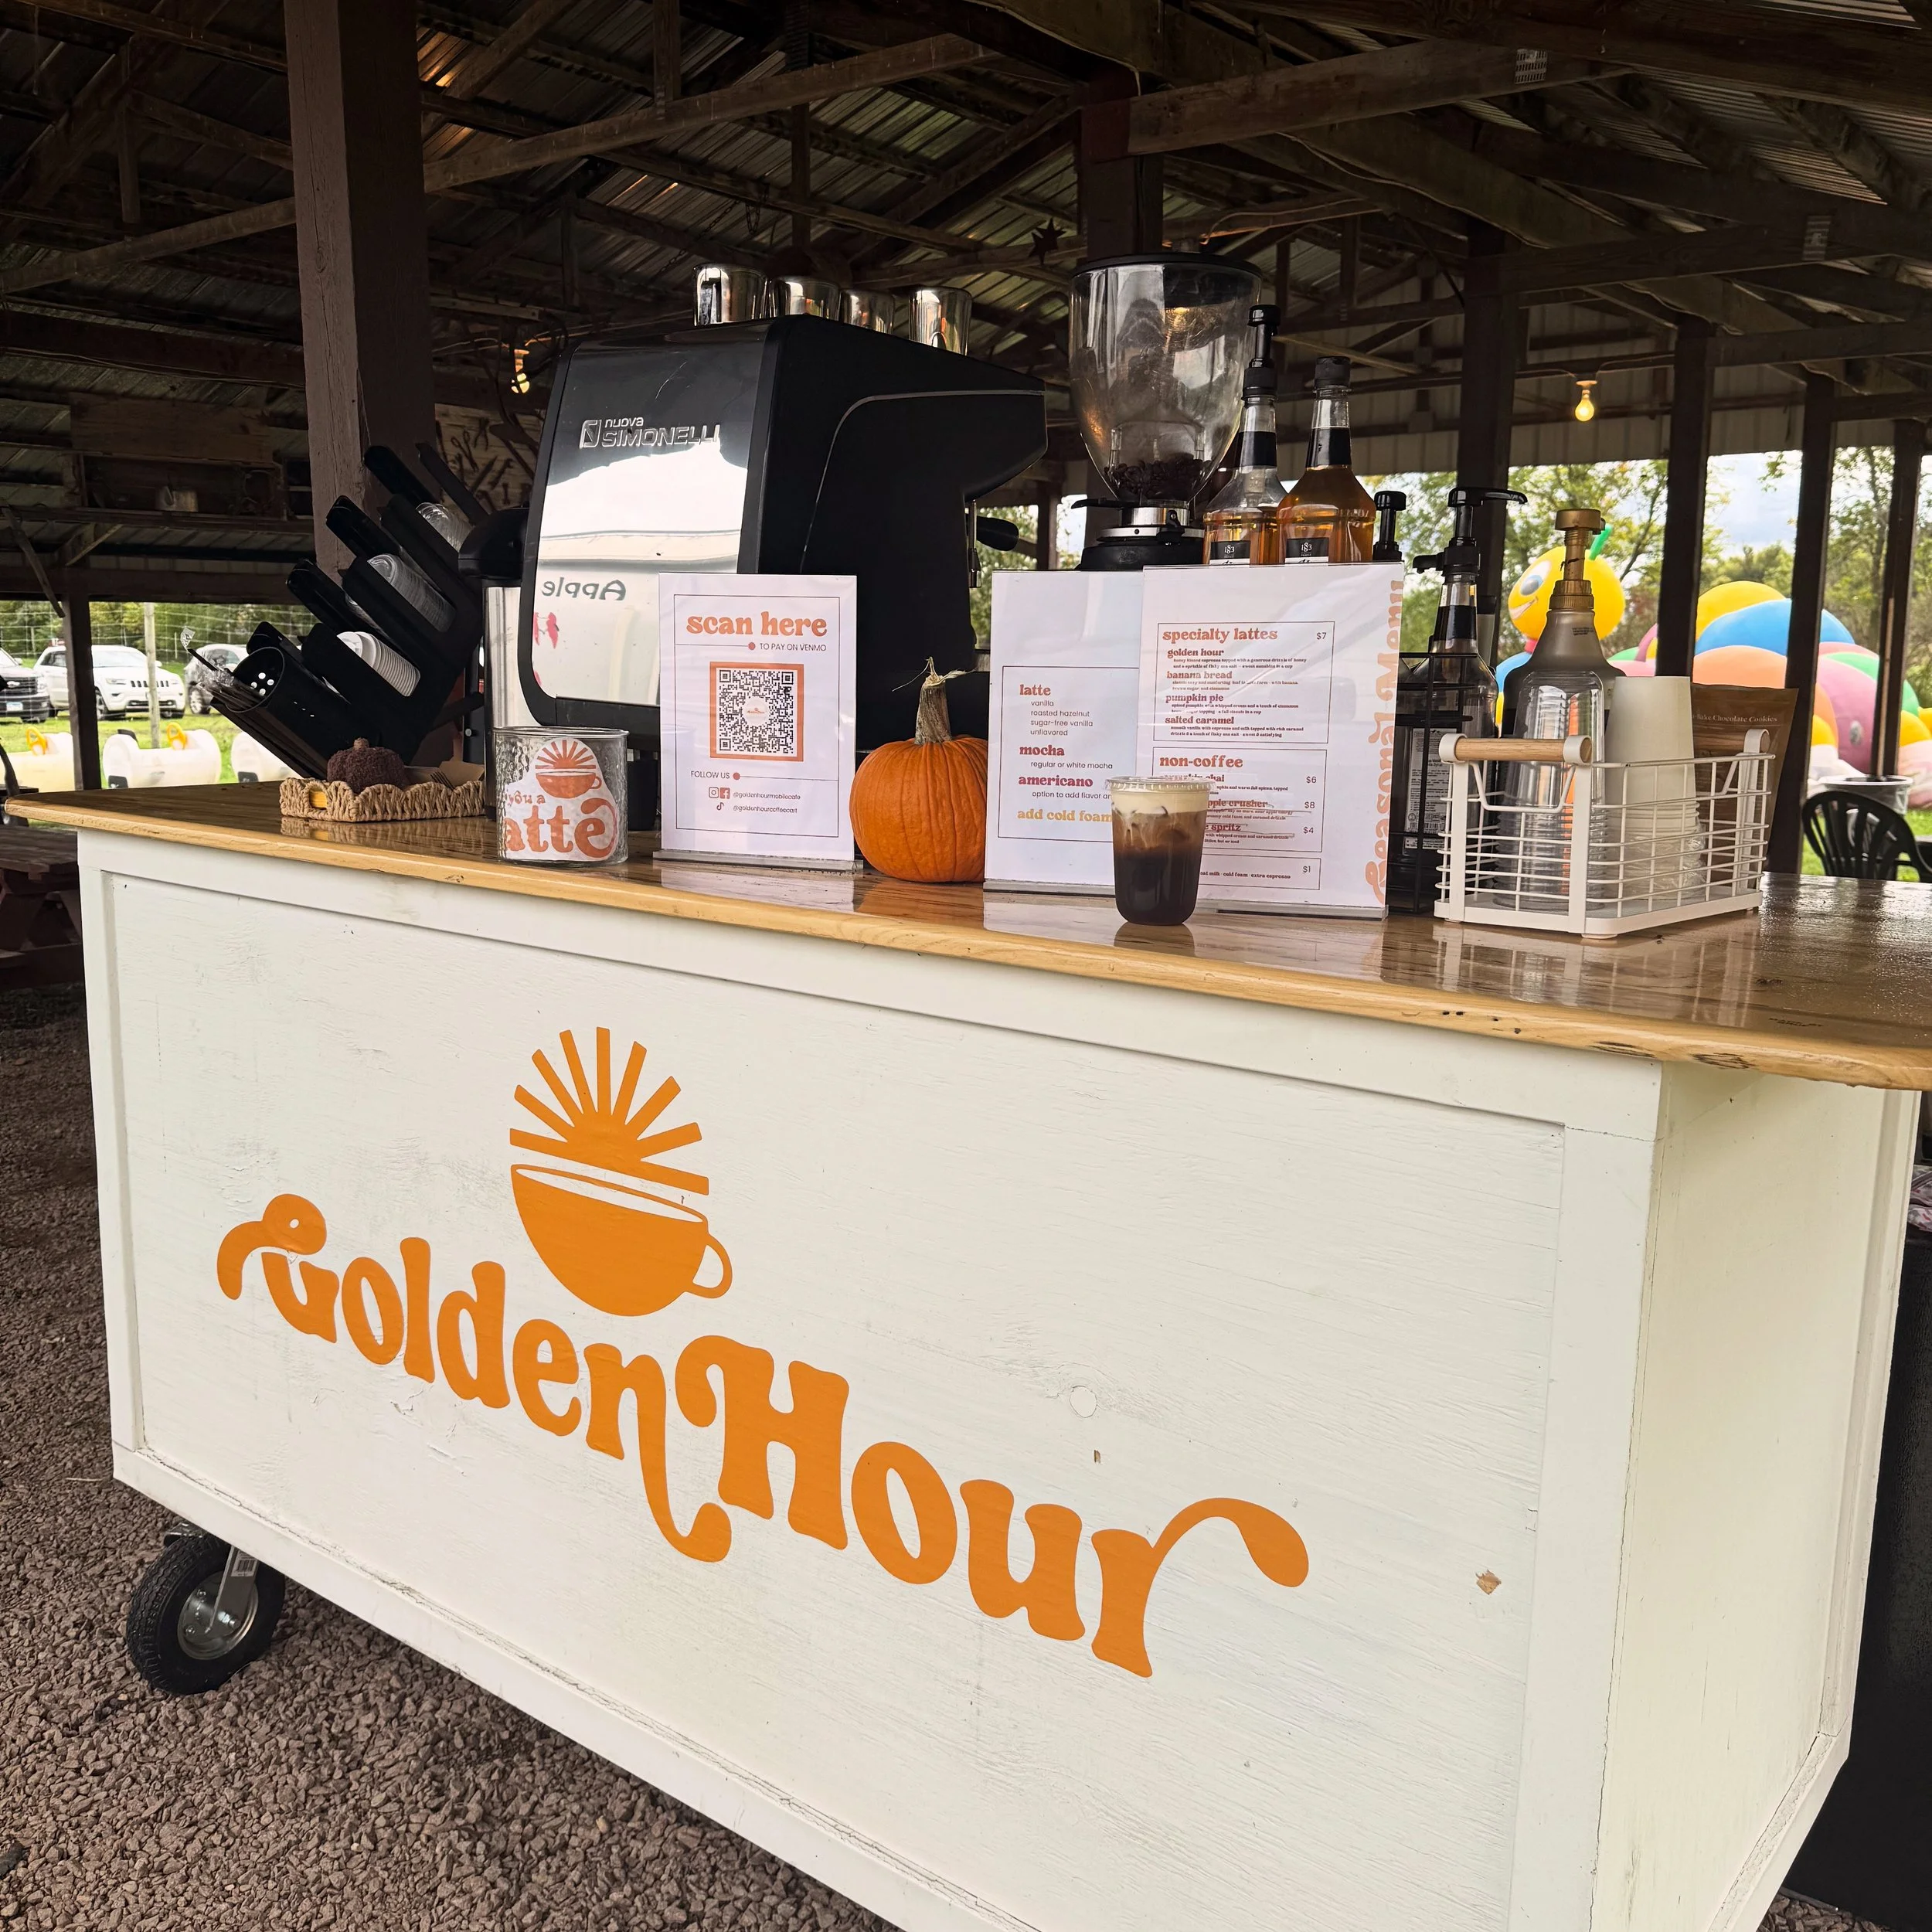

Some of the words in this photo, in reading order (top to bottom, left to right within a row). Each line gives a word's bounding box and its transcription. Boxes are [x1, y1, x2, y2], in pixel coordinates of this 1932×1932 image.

[605, 417, 644, 428] nuova
[602, 424, 720, 448] SIMONELLI
[686, 616, 753, 634] scan
[760, 611, 828, 636] here
[1162, 628, 1230, 645] specialty
[1234, 628, 1278, 641] lattes
[1316, 631, 1327, 641] $7
[1168, 648, 1199, 659] golden
[1201, 648, 1224, 657] hour
[1167, 671, 1202, 679] banana
[1203, 671, 1233, 679] bread
[1019, 684, 1051, 696] latte
[1165, 693, 1207, 704] pumpkin
[1209, 693, 1224, 704] pie
[1165, 716, 1194, 724] salted
[1019, 744, 1066, 757] mocha
[1160, 755, 1243, 768] non-coffee
[691, 770, 719, 779] FOLLOW
[720, 771, 730, 780] US
[1018, 774, 1094, 787] americano
[1306, 776, 1317, 784] $6
[1229, 799, 1268, 808] crusher
[1017, 808, 1043, 820] add
[1046, 810, 1075, 821] cold
[1079, 811, 1112, 822] foam
[1211, 823, 1241, 832] spritz
[1303, 826, 1314, 835] $4
[1302, 866, 1311, 874] $1
[216, 1193, 732, 1563] Golden
[675, 1335, 1309, 1678] Hour
